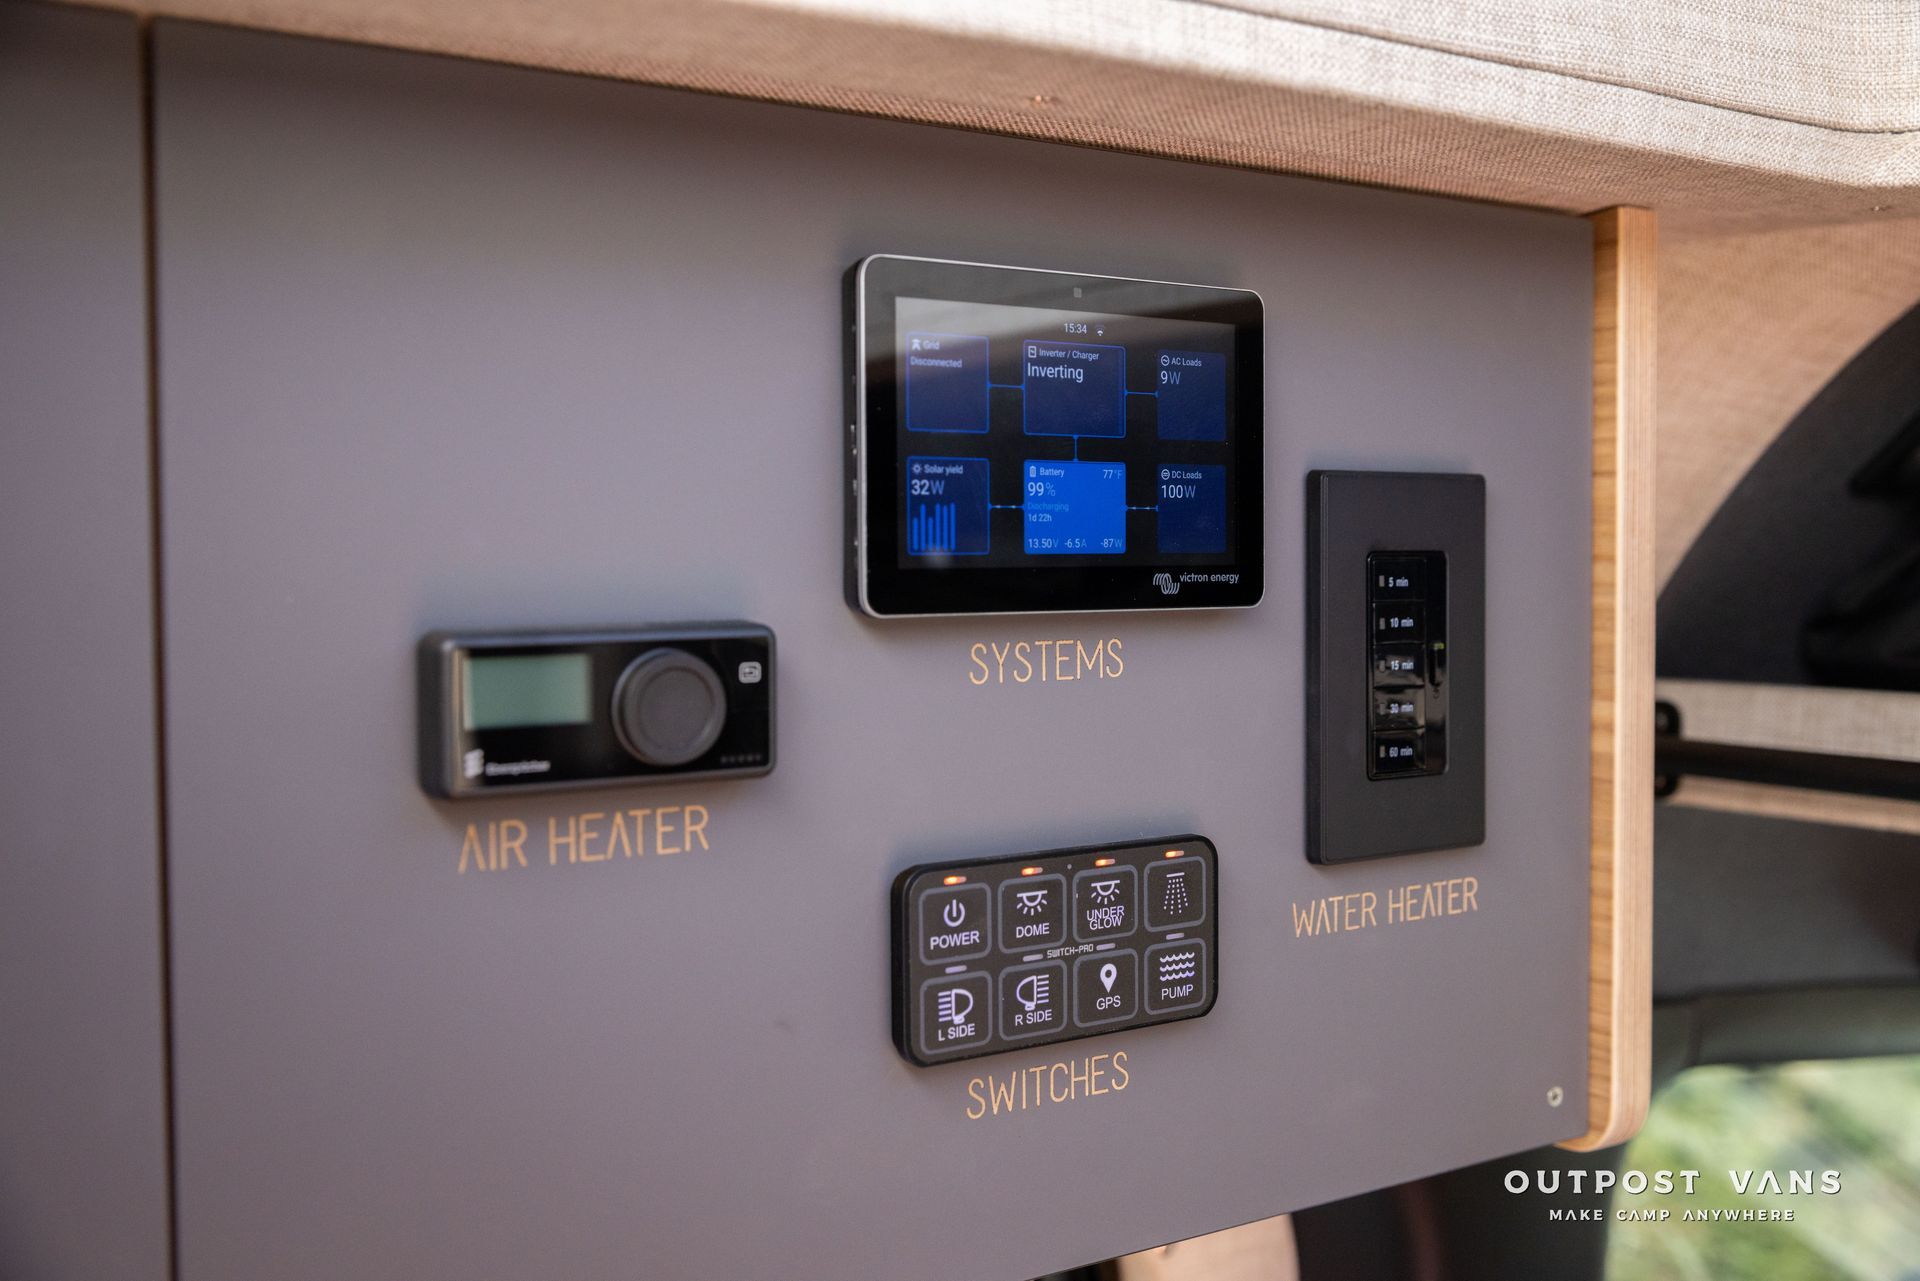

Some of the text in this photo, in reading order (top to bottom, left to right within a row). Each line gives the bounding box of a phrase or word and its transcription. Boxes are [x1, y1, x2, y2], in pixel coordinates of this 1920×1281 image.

[1064, 323, 1088, 334] 15:34
[922, 340, 940, 350] Grid
[1039, 348, 1066, 358] Inverter
[1072, 350, 1100, 361] Charger
[910, 356, 963, 368] Disconnected
[1171, 358, 1202, 367] AC Loads
[1027, 362, 1084, 383] Inverting
[924, 464, 964, 476] Solar yield
[1040, 466, 1064, 478] Battery
[1171, 471, 1202, 479] DC Loads
[911, 479, 945, 496] 32W
[1027, 482, 1056, 497] 99%
[1161, 485, 1196, 499] 100W
[1027, 502, 1069, 512] Discharging
[1028, 513, 1052, 522] 1d 22h
[1180, 572, 1239, 584] victron energy
[1388, 576, 1408, 587] 5 min
[1390, 617, 1414, 628] 10 min
[969, 638, 1124, 685] SYSTEMS
[1390, 659, 1414, 671] 15 min
[1390, 702, 1414, 714] 30 min
[1389, 746, 1413, 757] 60 min
[458, 805, 709, 874] AIR HEATER
[1086, 905, 1125, 921] UNDER
[1292, 876, 1479, 938] WATER HEATER
[1089, 915, 1122, 930] GLOW
[1016, 923, 1050, 938] DOME
[930, 930, 980, 950] POWER
[1047, 944, 1094, 958] SWITCH-PRO
[1161, 984, 1194, 1000] PUMP
[1096, 995, 1121, 1010] GPS
[1015, 1009, 1052, 1026] R SIDE
[938, 1023, 975, 1041] L SIDE
[966, 1051, 1129, 1119] SWITCHES
